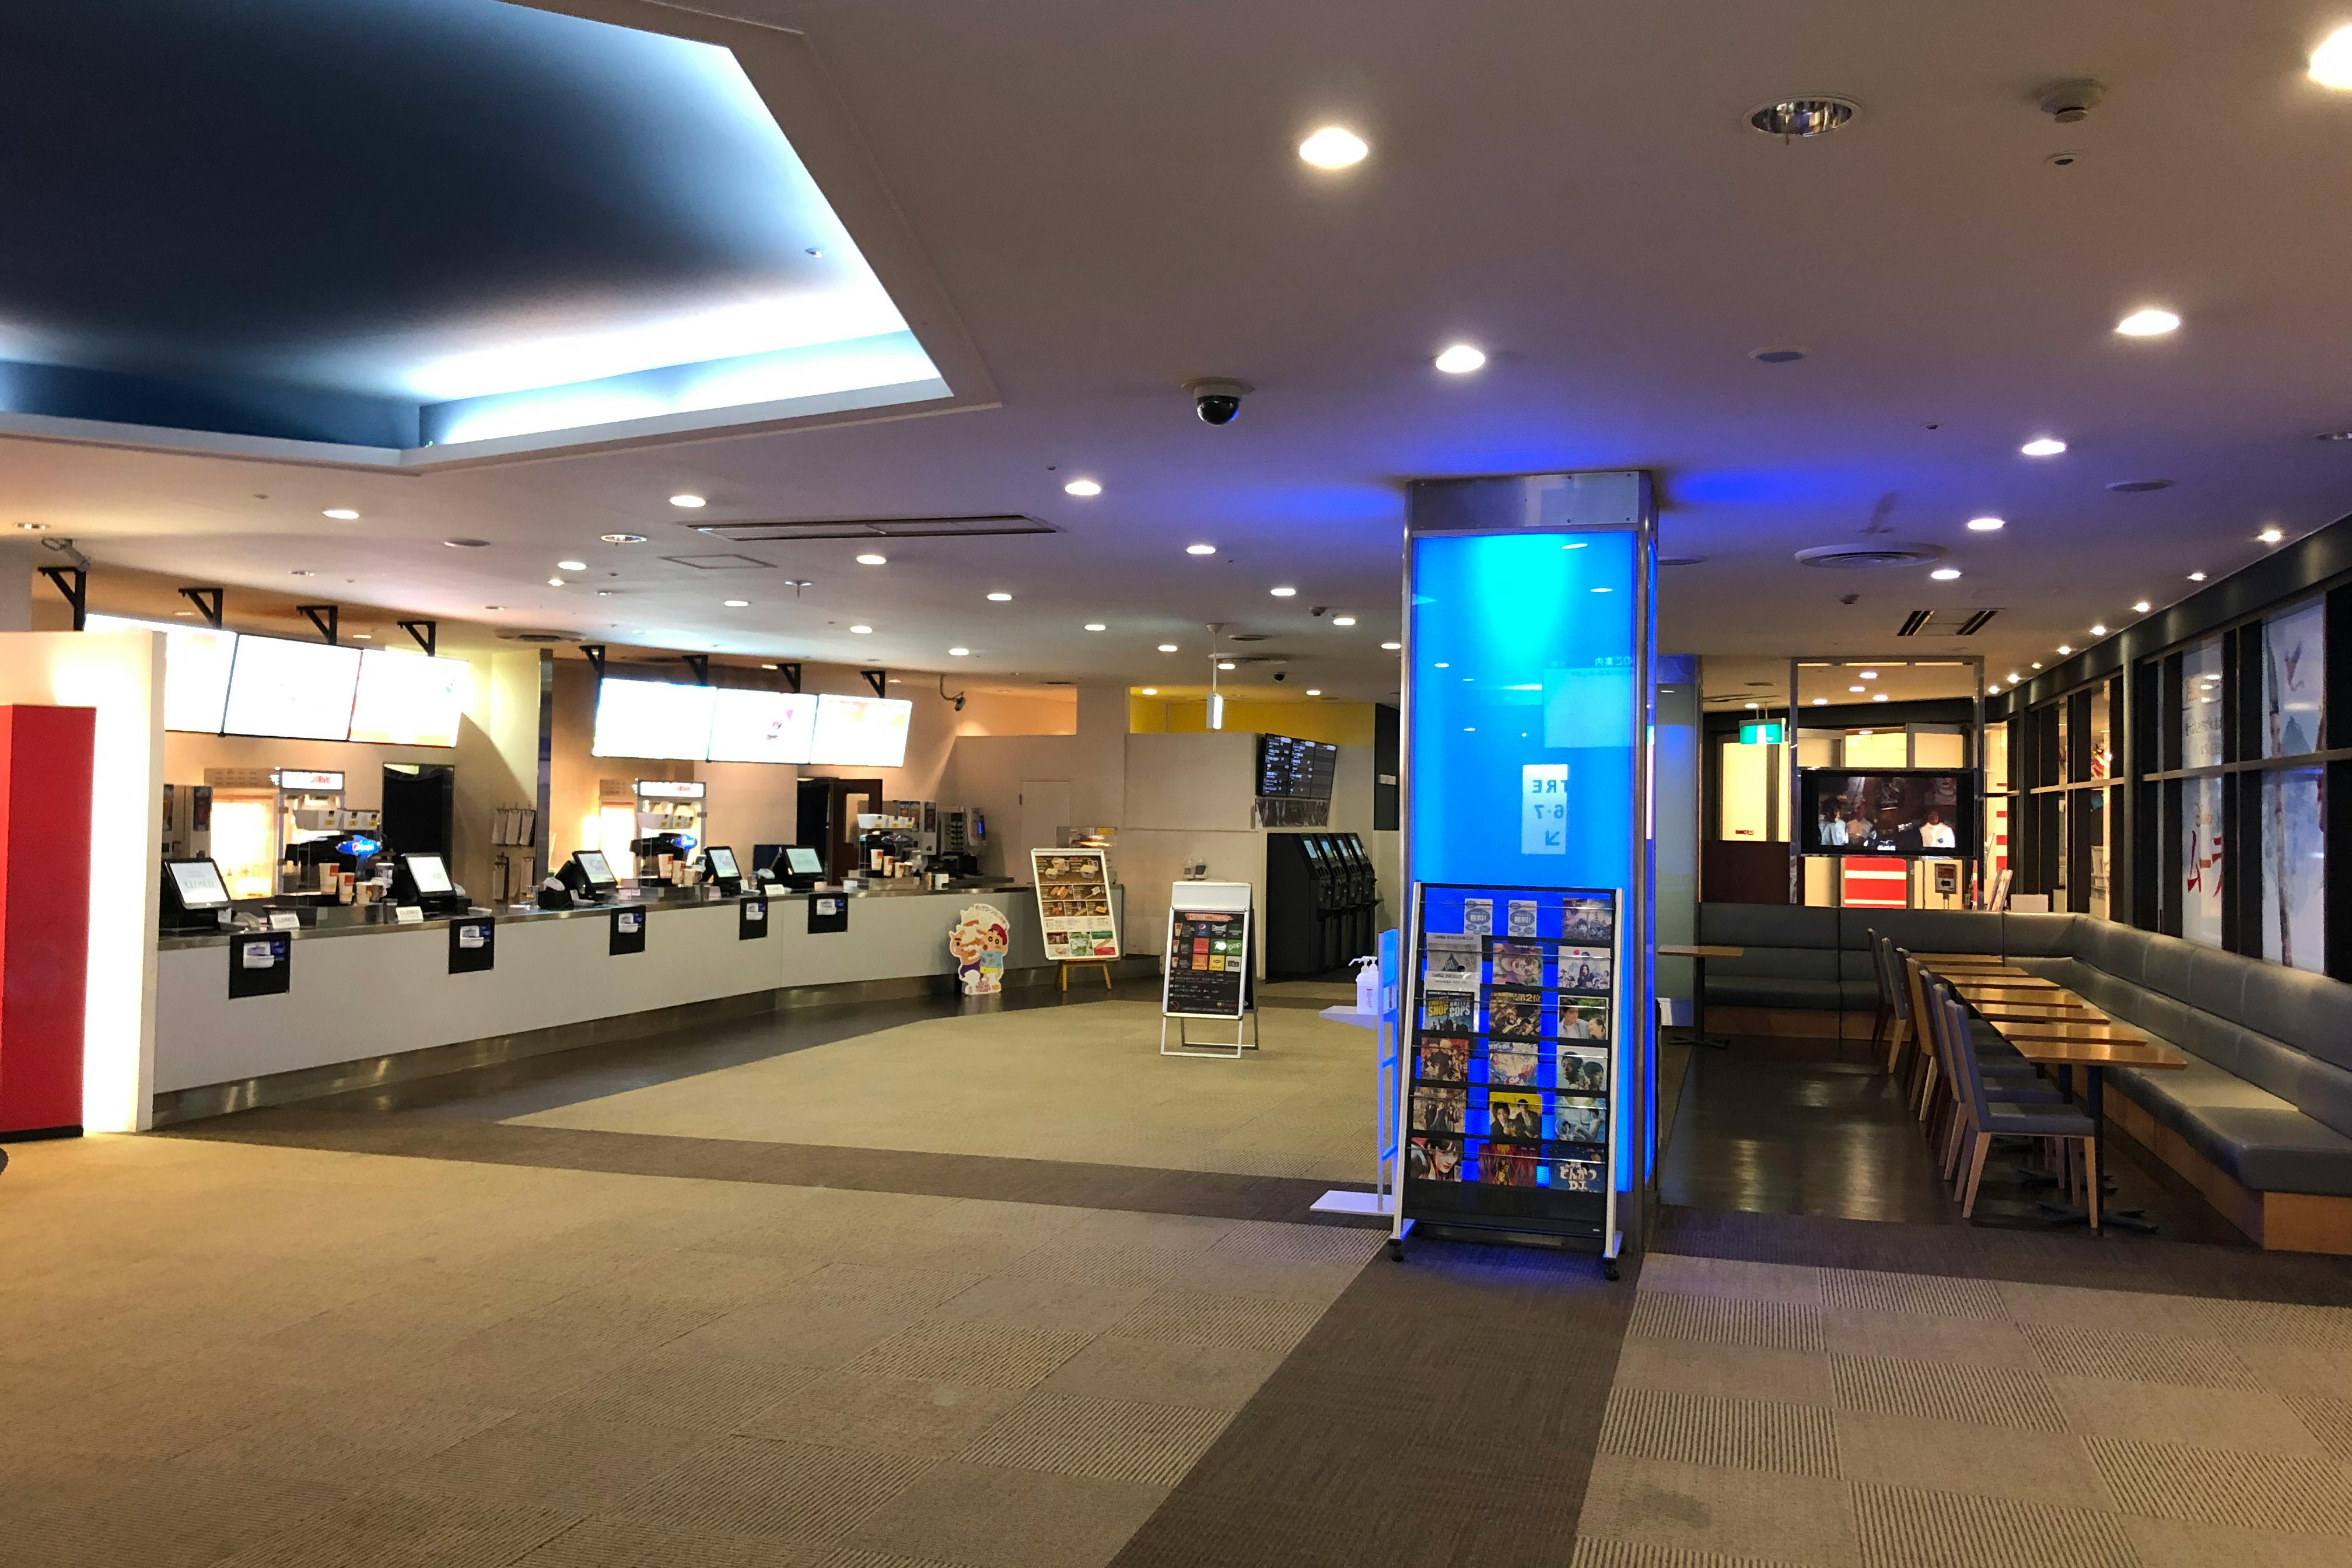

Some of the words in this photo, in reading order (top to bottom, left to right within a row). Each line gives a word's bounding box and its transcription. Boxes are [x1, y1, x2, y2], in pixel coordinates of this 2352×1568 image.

[1428, 1005, 1448, 1017] SHOP
[1449, 1005, 1471, 1017] COPS
[1560, 1166, 1597, 1181] とんかつ
